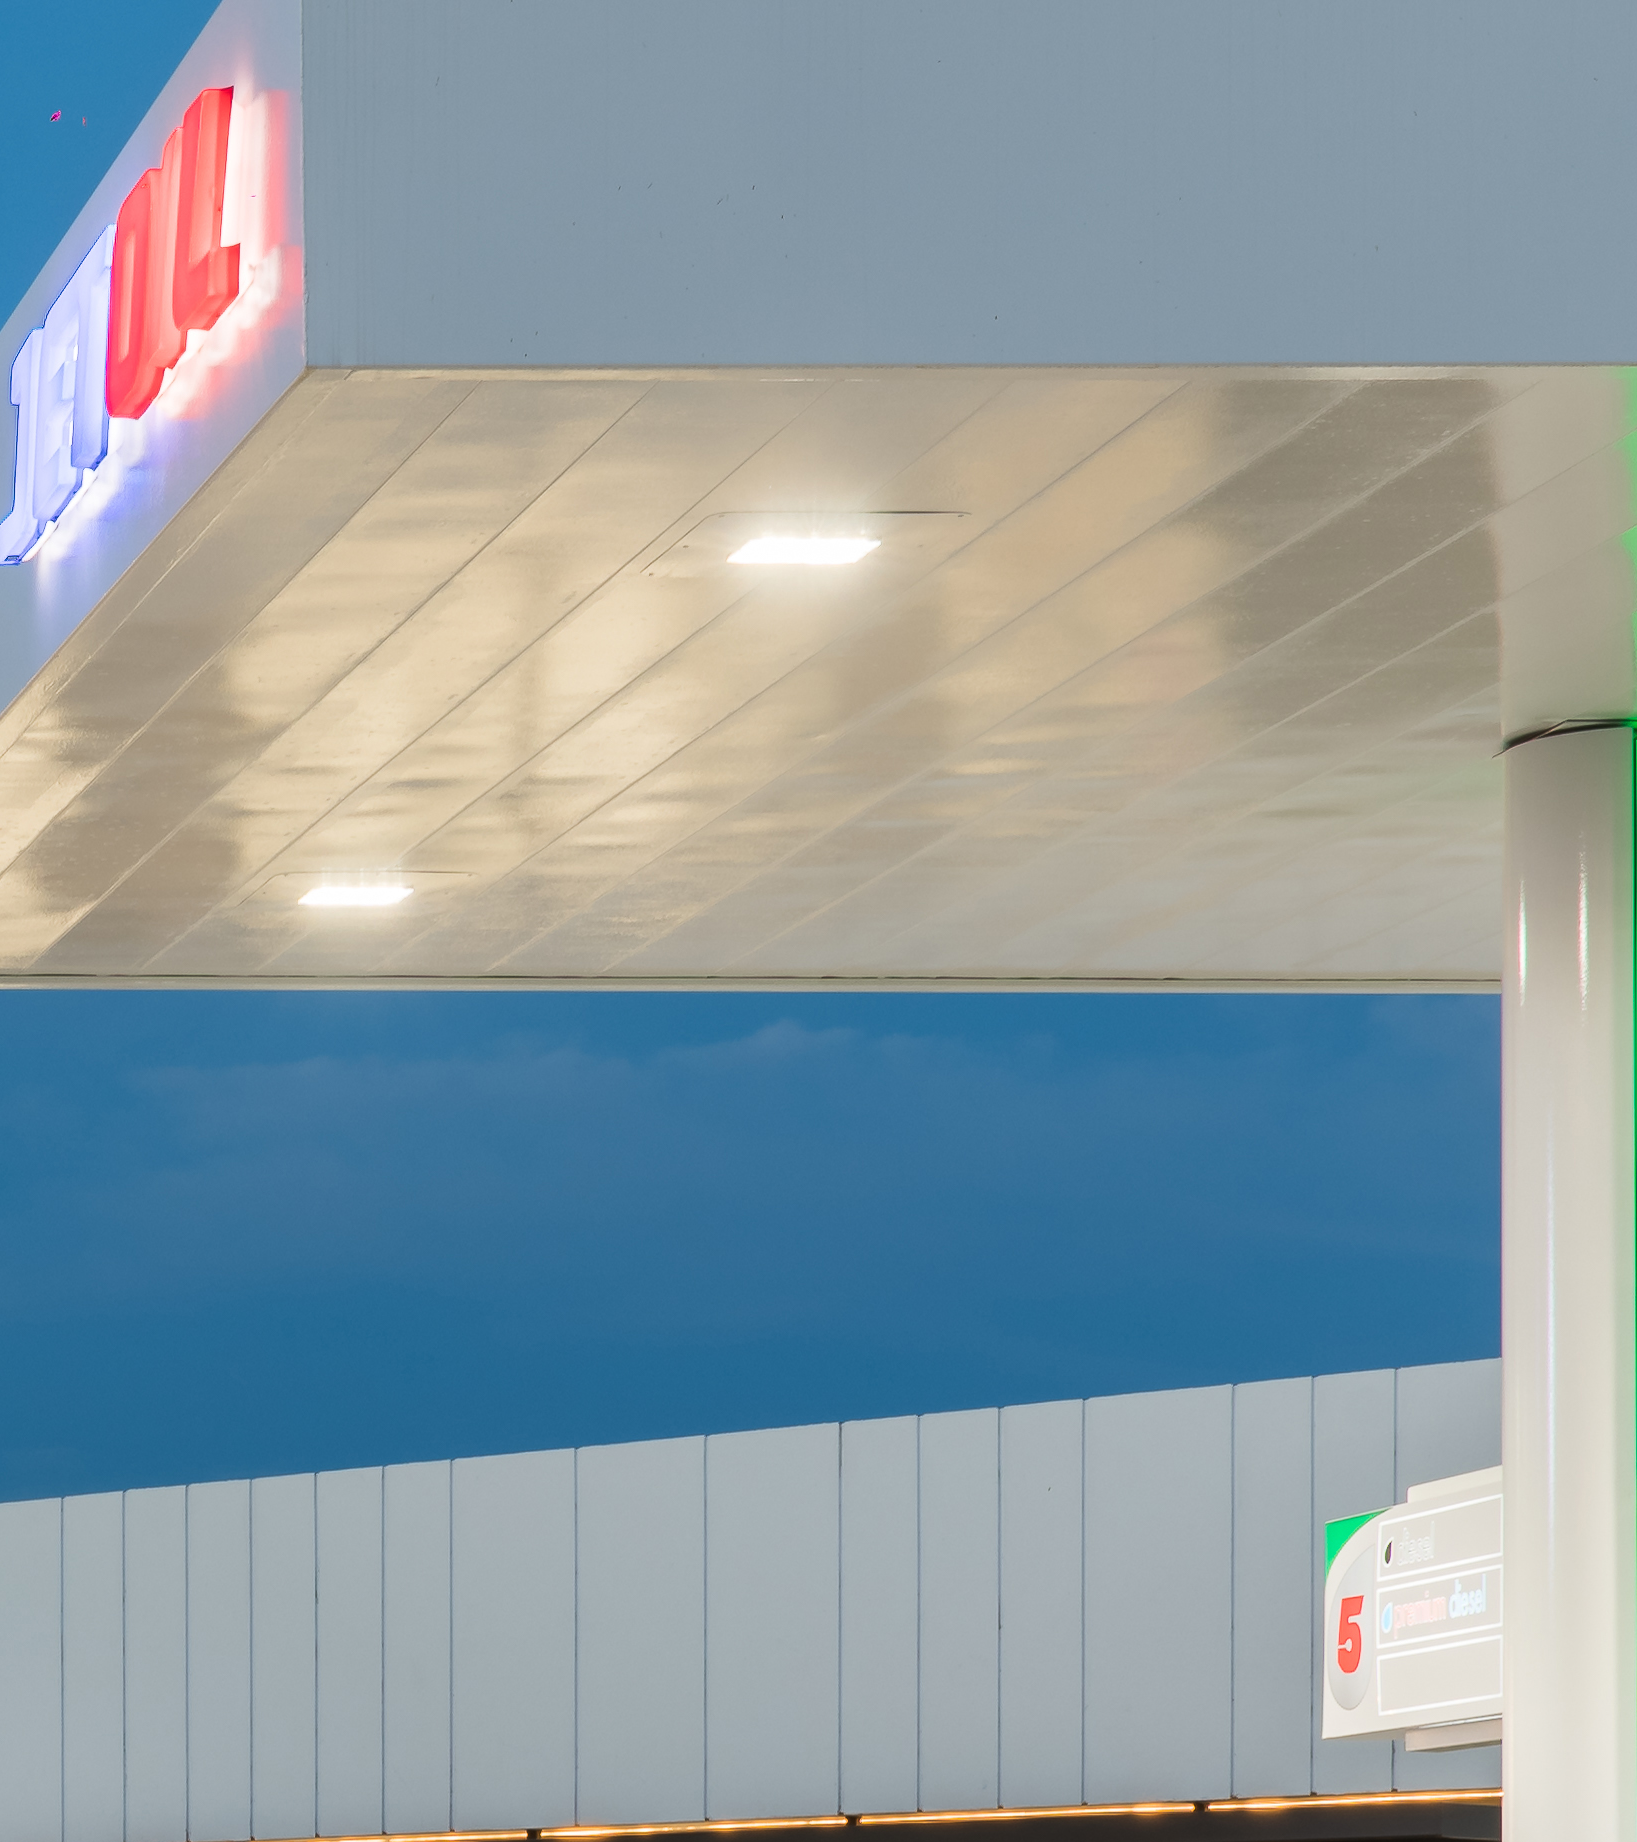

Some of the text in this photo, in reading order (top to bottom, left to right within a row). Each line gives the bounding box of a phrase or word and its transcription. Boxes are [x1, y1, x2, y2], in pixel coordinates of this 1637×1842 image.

[1397, 1521, 1435, 1566] diesel
[1338, 1595, 1364, 1674] 5
[1394, 1573, 1487, 1639] premium diesel
